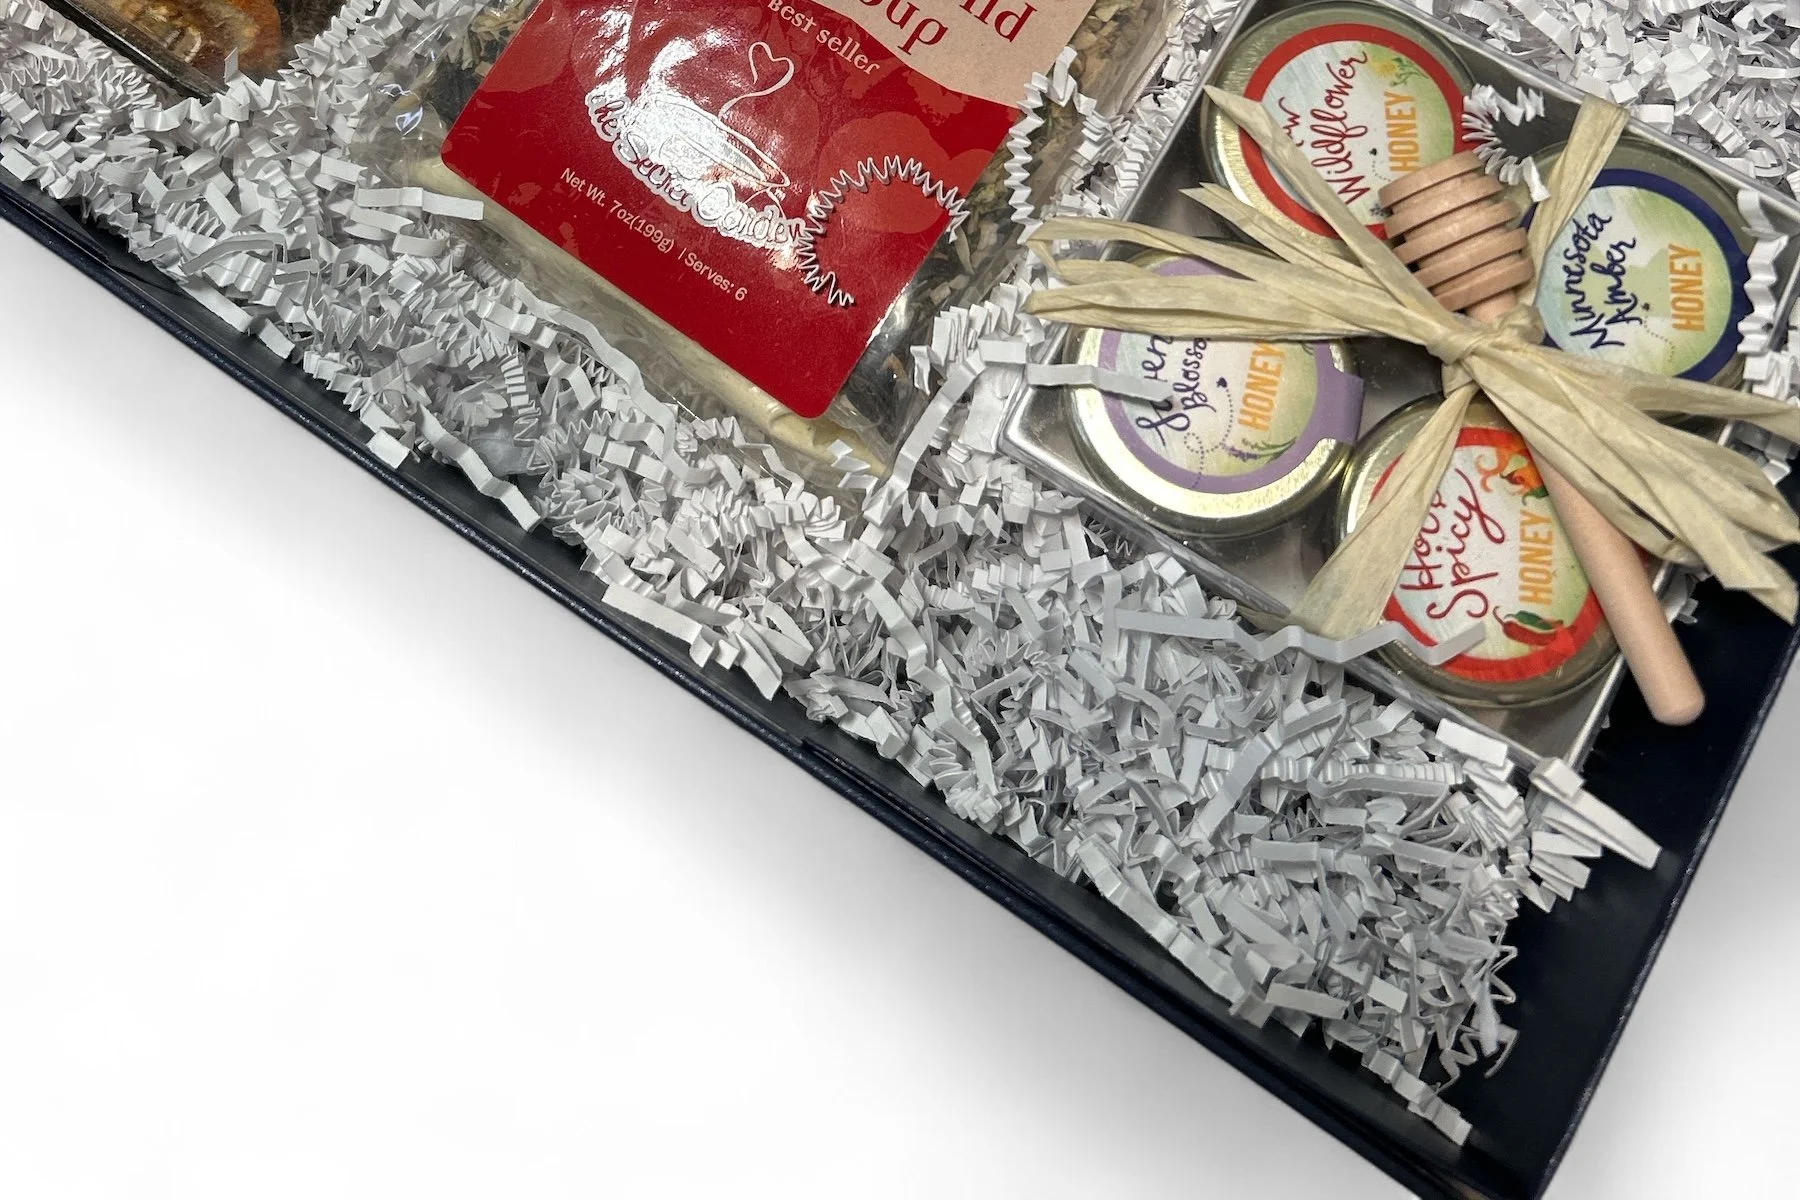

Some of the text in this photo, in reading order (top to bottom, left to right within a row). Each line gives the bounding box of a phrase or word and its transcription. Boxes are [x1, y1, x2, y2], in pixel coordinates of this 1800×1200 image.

[816, 29, 881, 75] seller
[1309, 51, 1371, 205] Wildflower
[1384, 89, 1421, 172] HONEY
[560, 167, 586, 192] Net
[586, 184, 607, 208] Wt.
[684, 252, 735, 293] Serves:
[734, 286, 748, 301] 6
[1562, 212, 1625, 349] Minnesota
[1589, 237, 1643, 325] Amber
[1668, 243, 1705, 333] HONEY
[1172, 338, 1217, 413] Blosso
[1238, 340, 1286, 432] HONEY
[1426, 468, 1505, 619] Spicy
[1519, 508, 1553, 605] HONEY
